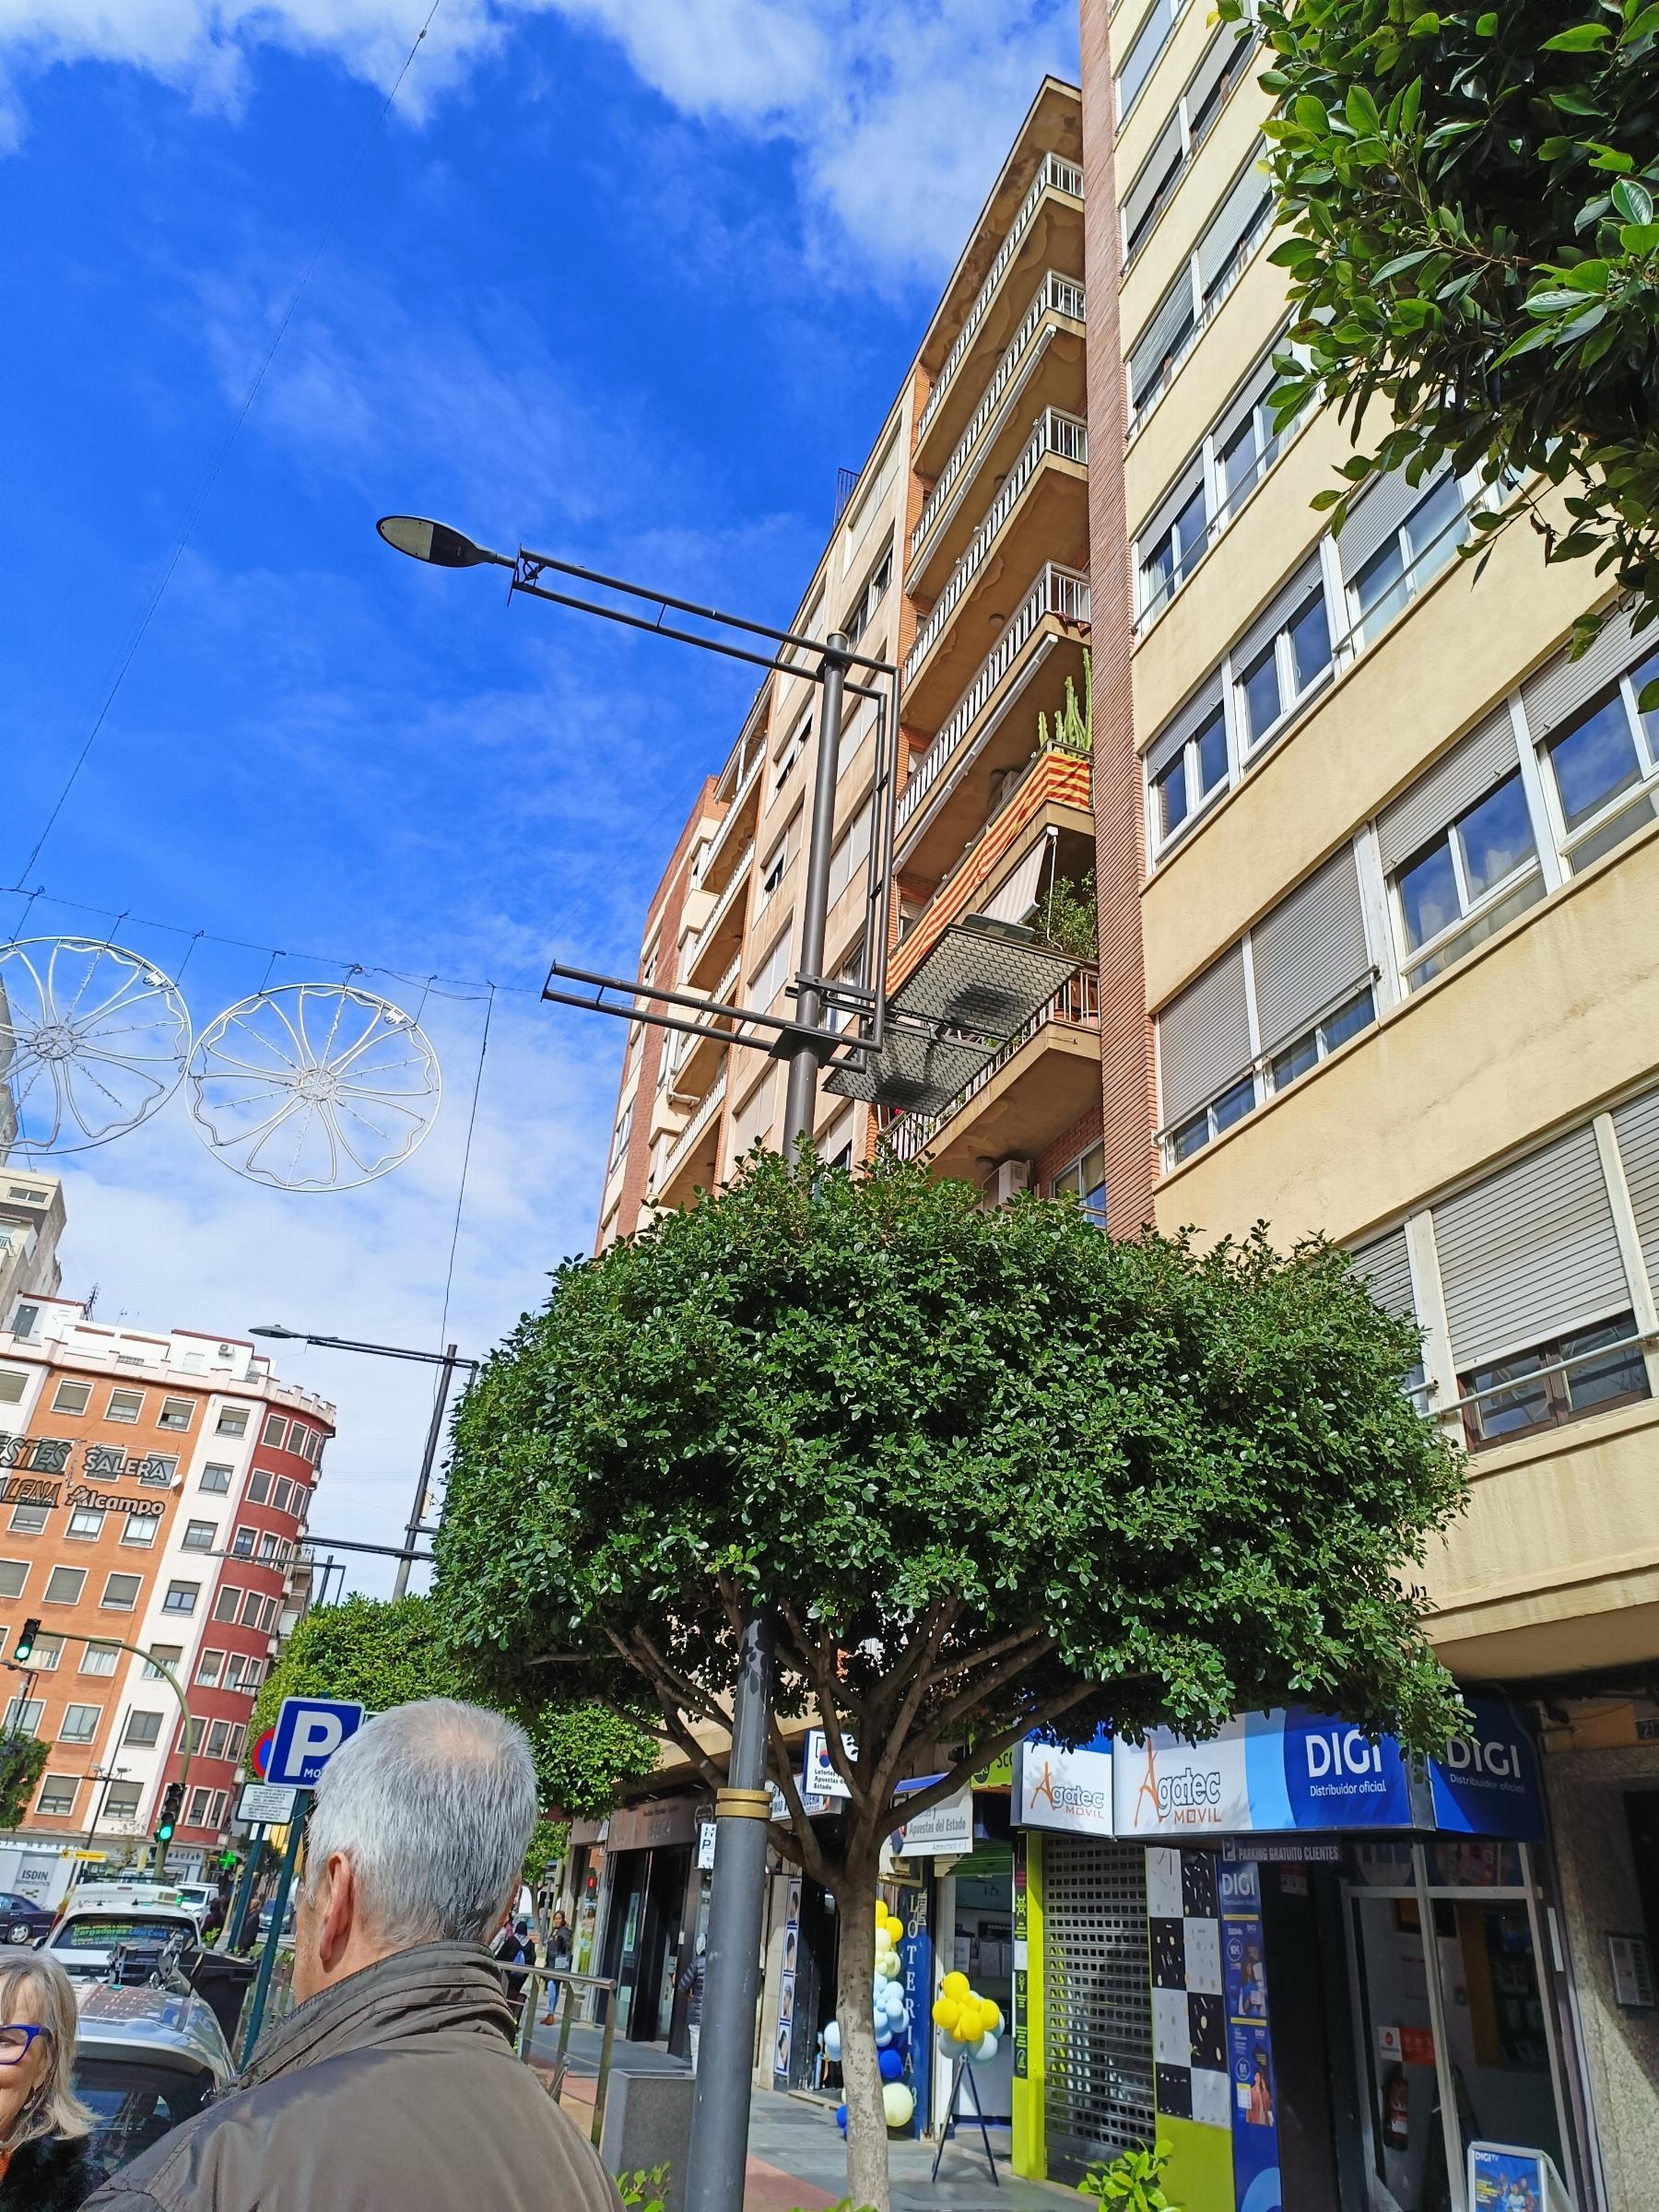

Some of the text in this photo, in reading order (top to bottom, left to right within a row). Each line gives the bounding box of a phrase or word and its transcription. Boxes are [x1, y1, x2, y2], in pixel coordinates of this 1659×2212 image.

[84, 1449, 167, 1481] SALERA
[284, 1710, 342, 1776] P
[1305, 1729, 1382, 1777] DIGI
[1446, 1735, 1521, 1779] DIGI
[303, 1768, 324, 1778] MO
[1450, 1772, 1526, 1794] Distribuidor oficial
[1310, 1780, 1387, 1797] Distribuidor oficial
[1065, 1806, 1105, 1819] MOVIL
[1174, 1808, 1222, 1825] MOVIL
[909, 1817, 967, 1838] Apuestas del Estado
[1238, 1846, 1268, 1861] PARKING
[1269, 1846, 1302, 1861] GRATUITO
[1303, 1845, 1339, 1861] CLIENTES
[22, 1869, 49, 1880] ISDIN
[1221, 1872, 1255, 1896] DIGI
[903, 1894, 919, 2075] LOTERIA
[1475, 2151, 1491, 2162] DIGI
